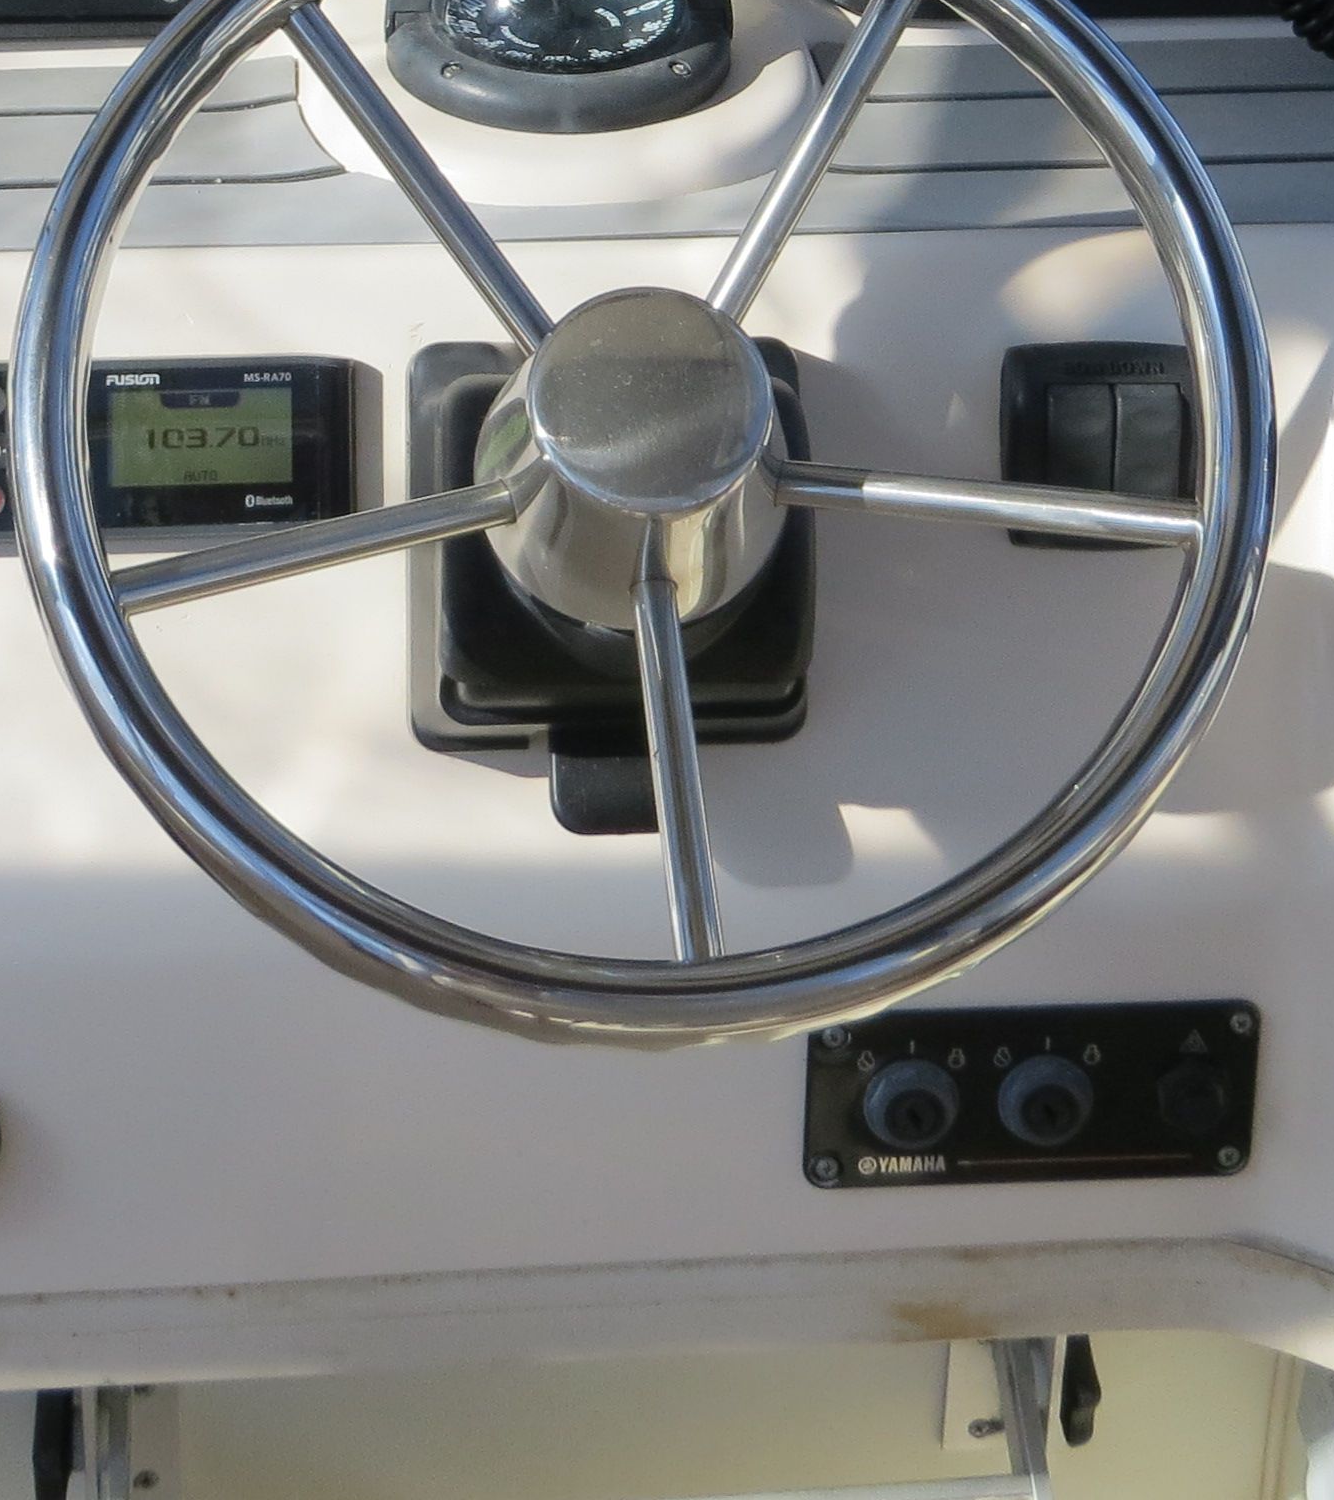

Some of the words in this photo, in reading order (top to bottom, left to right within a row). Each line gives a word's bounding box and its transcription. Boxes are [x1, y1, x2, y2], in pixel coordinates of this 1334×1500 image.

[105, 373, 161, 387] FUSION
[243, 372, 292, 383] MS-RA70
[189, 394, 211, 406] FM
[147, 426, 260, 450] 103.70
[183, 469, 218, 482] AUTO
[255, 495, 293, 506] Bluetooth
[878, 1154, 946, 1173] YAMAHA
